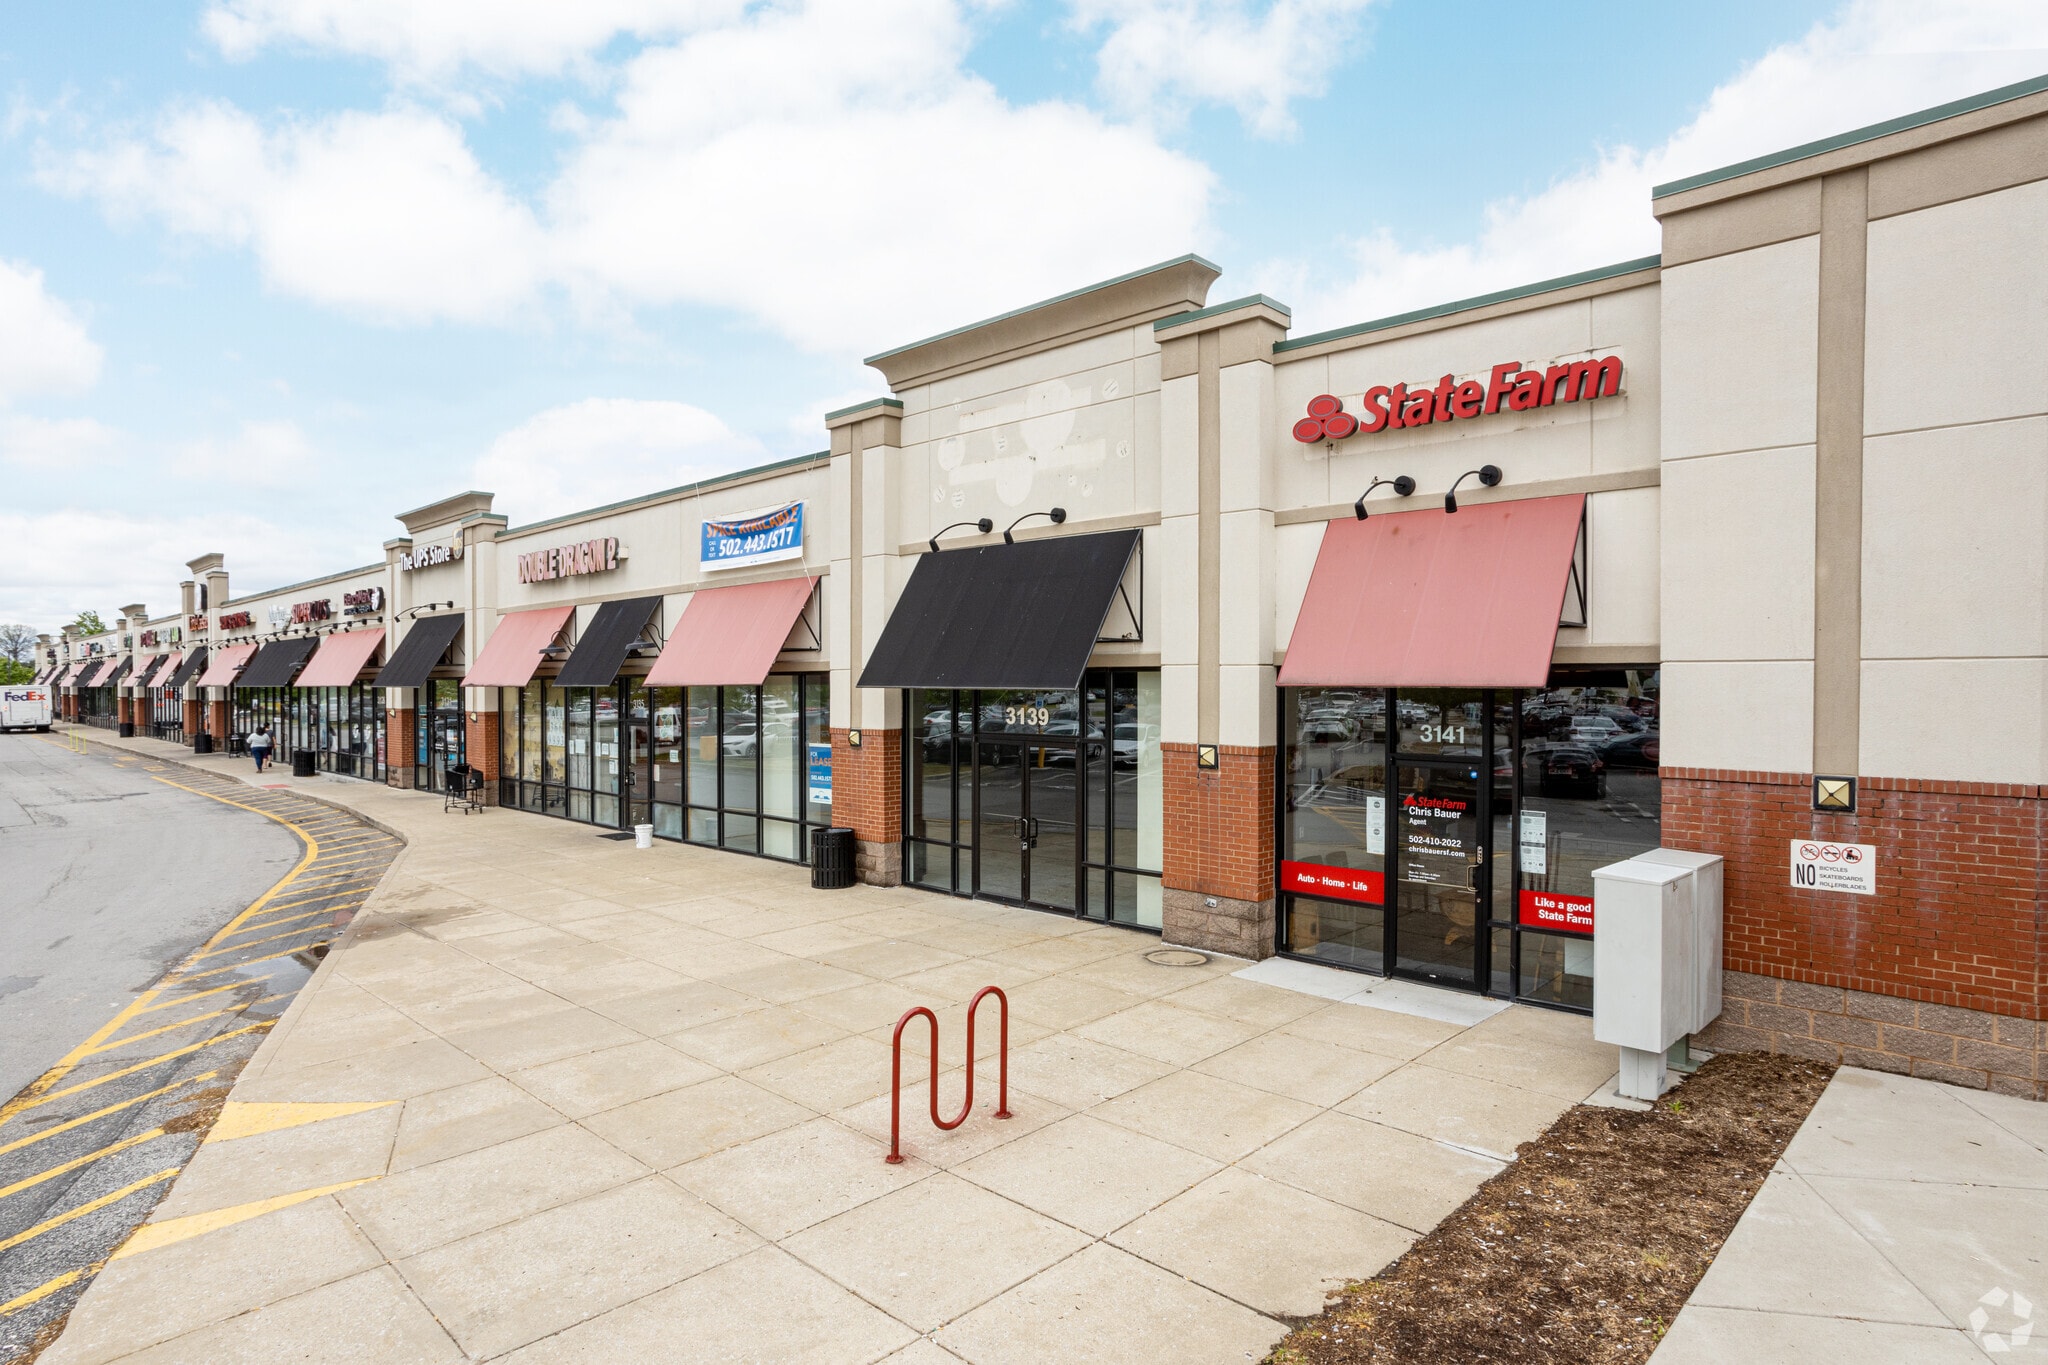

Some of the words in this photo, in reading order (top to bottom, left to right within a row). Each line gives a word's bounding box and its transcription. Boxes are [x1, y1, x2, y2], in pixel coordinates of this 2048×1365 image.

[739, 506, 799, 534] AVAILABLE
[719, 526, 794, 556] 502.443.1577
[400, 553, 413, 572] The
[413, 546, 429, 569] UPS
[429, 545, 450, 566] Store
[518, 549, 557, 584] DOUBLE
[558, 539, 606, 578] DRAGON
[606, 537, 618, 570] 2
[4, 691, 46, 702] FedEx
[1005, 706, 1049, 726] 3139
[1420, 724, 1464, 744] 3141
[1408, 806, 1432, 817] Chris
[1434, 808, 1461, 819] Bauer
[1409, 818, 1427, 826] Agent
[1408, 835, 1462, 848] 502-410-2022
[1408, 846, 1466, 857] chrisbauersf.com
[1297, 873, 1315, 883] Auto
[1322, 876, 1345, 888] Home
[1352, 881, 1368, 891] Life
[1796, 863, 1816, 886] NO
[1819, 873, 1864, 882] SKATEBOARDS
[1820, 881, 1867, 891] ROLLERBLADES
[1535, 897, 1555, 908] Like
[1558, 901, 1564, 909] a
[1566, 903, 1592, 913] good
[1538, 909, 1564, 921] State
[1566, 913, 1593, 925] Farm
